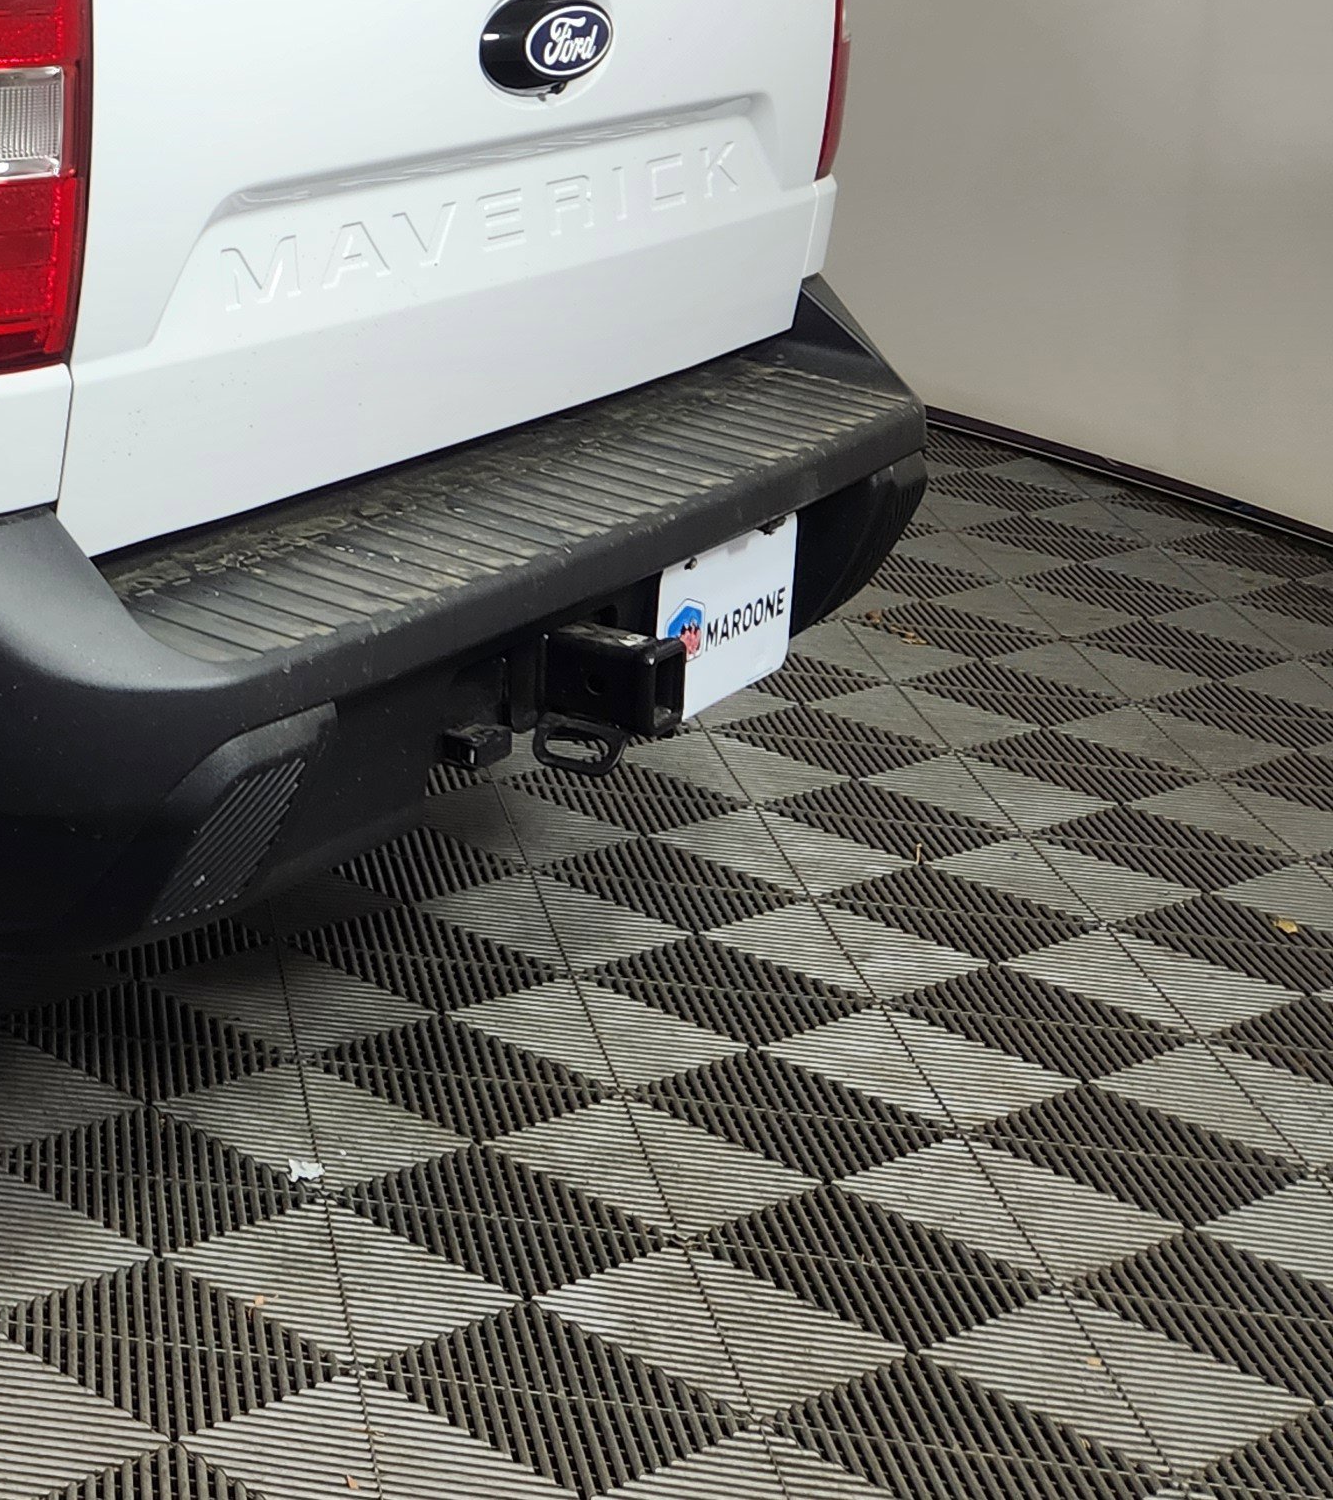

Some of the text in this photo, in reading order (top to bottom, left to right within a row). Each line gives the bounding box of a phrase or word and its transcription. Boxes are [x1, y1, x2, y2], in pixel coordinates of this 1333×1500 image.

[544, 15, 598, 67] Ford
[220, 139, 741, 311] MAVERICK
[705, 586, 786, 652] MAROONE
